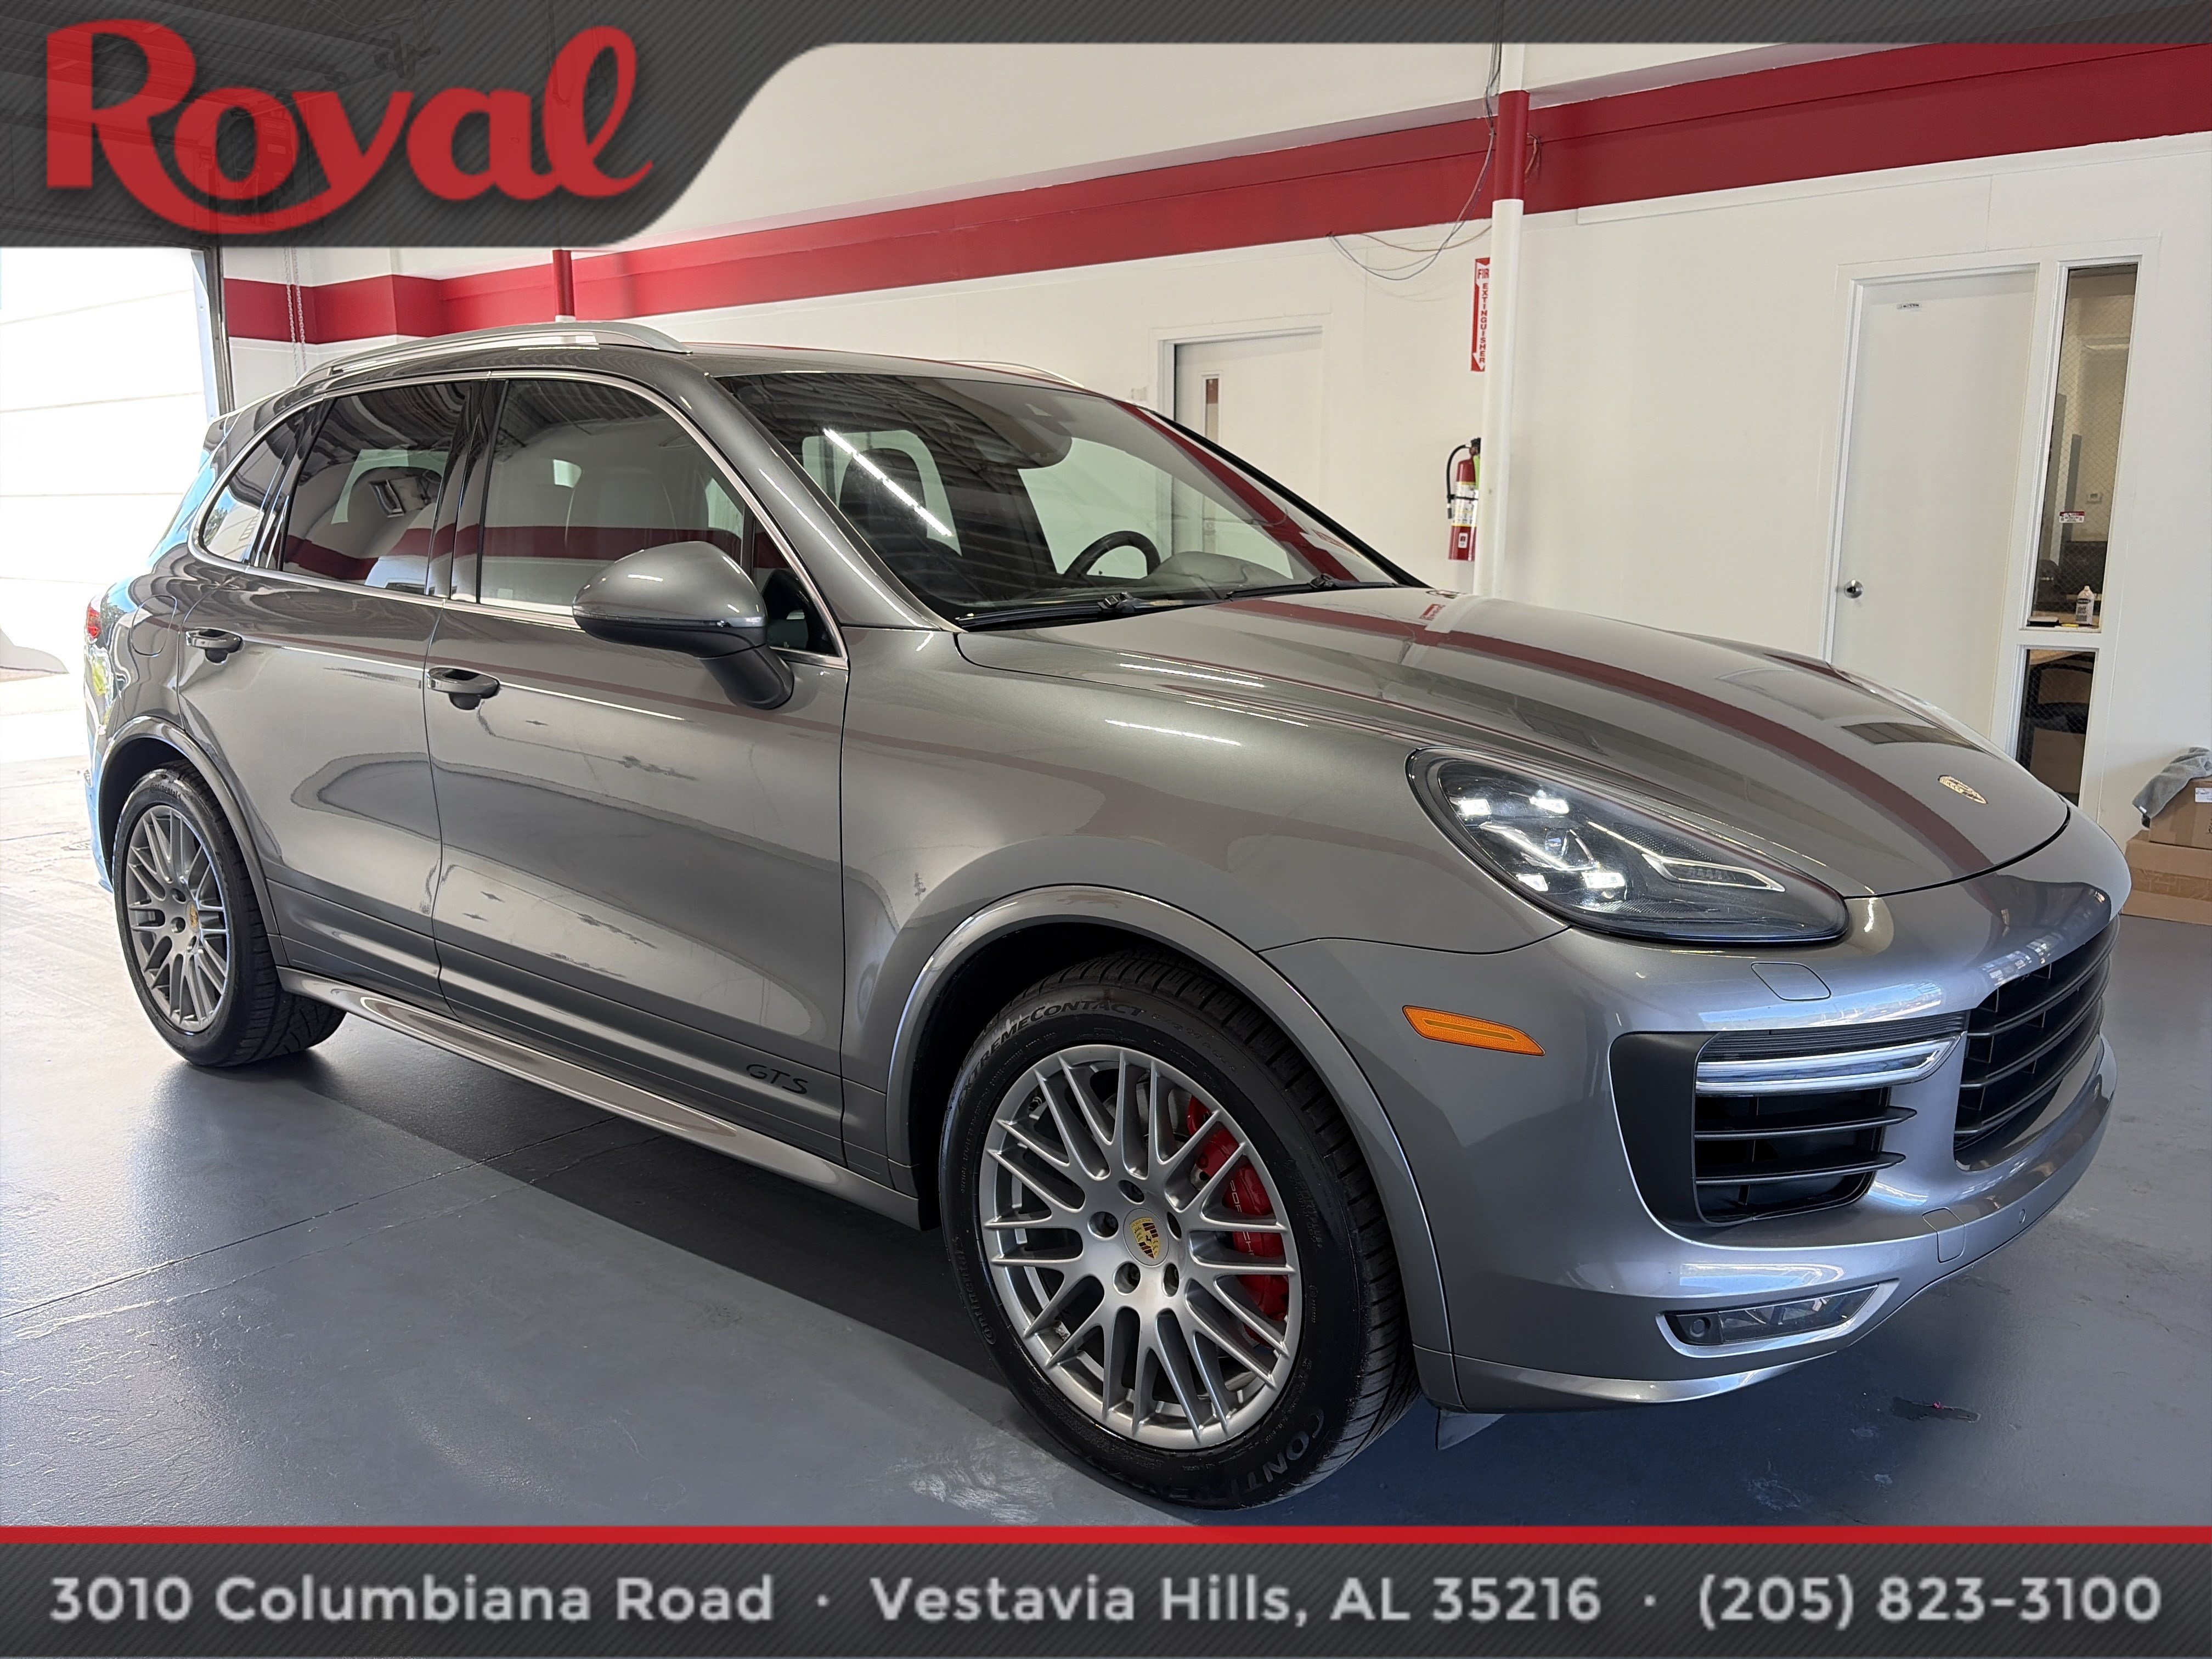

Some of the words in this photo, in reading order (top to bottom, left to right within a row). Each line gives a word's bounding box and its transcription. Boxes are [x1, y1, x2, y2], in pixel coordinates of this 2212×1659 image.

[1477, 268, 1490, 279] FIR
[1480, 283, 1488, 363] EXTINGUISHER
[746, 1064, 809, 1094] GTS
